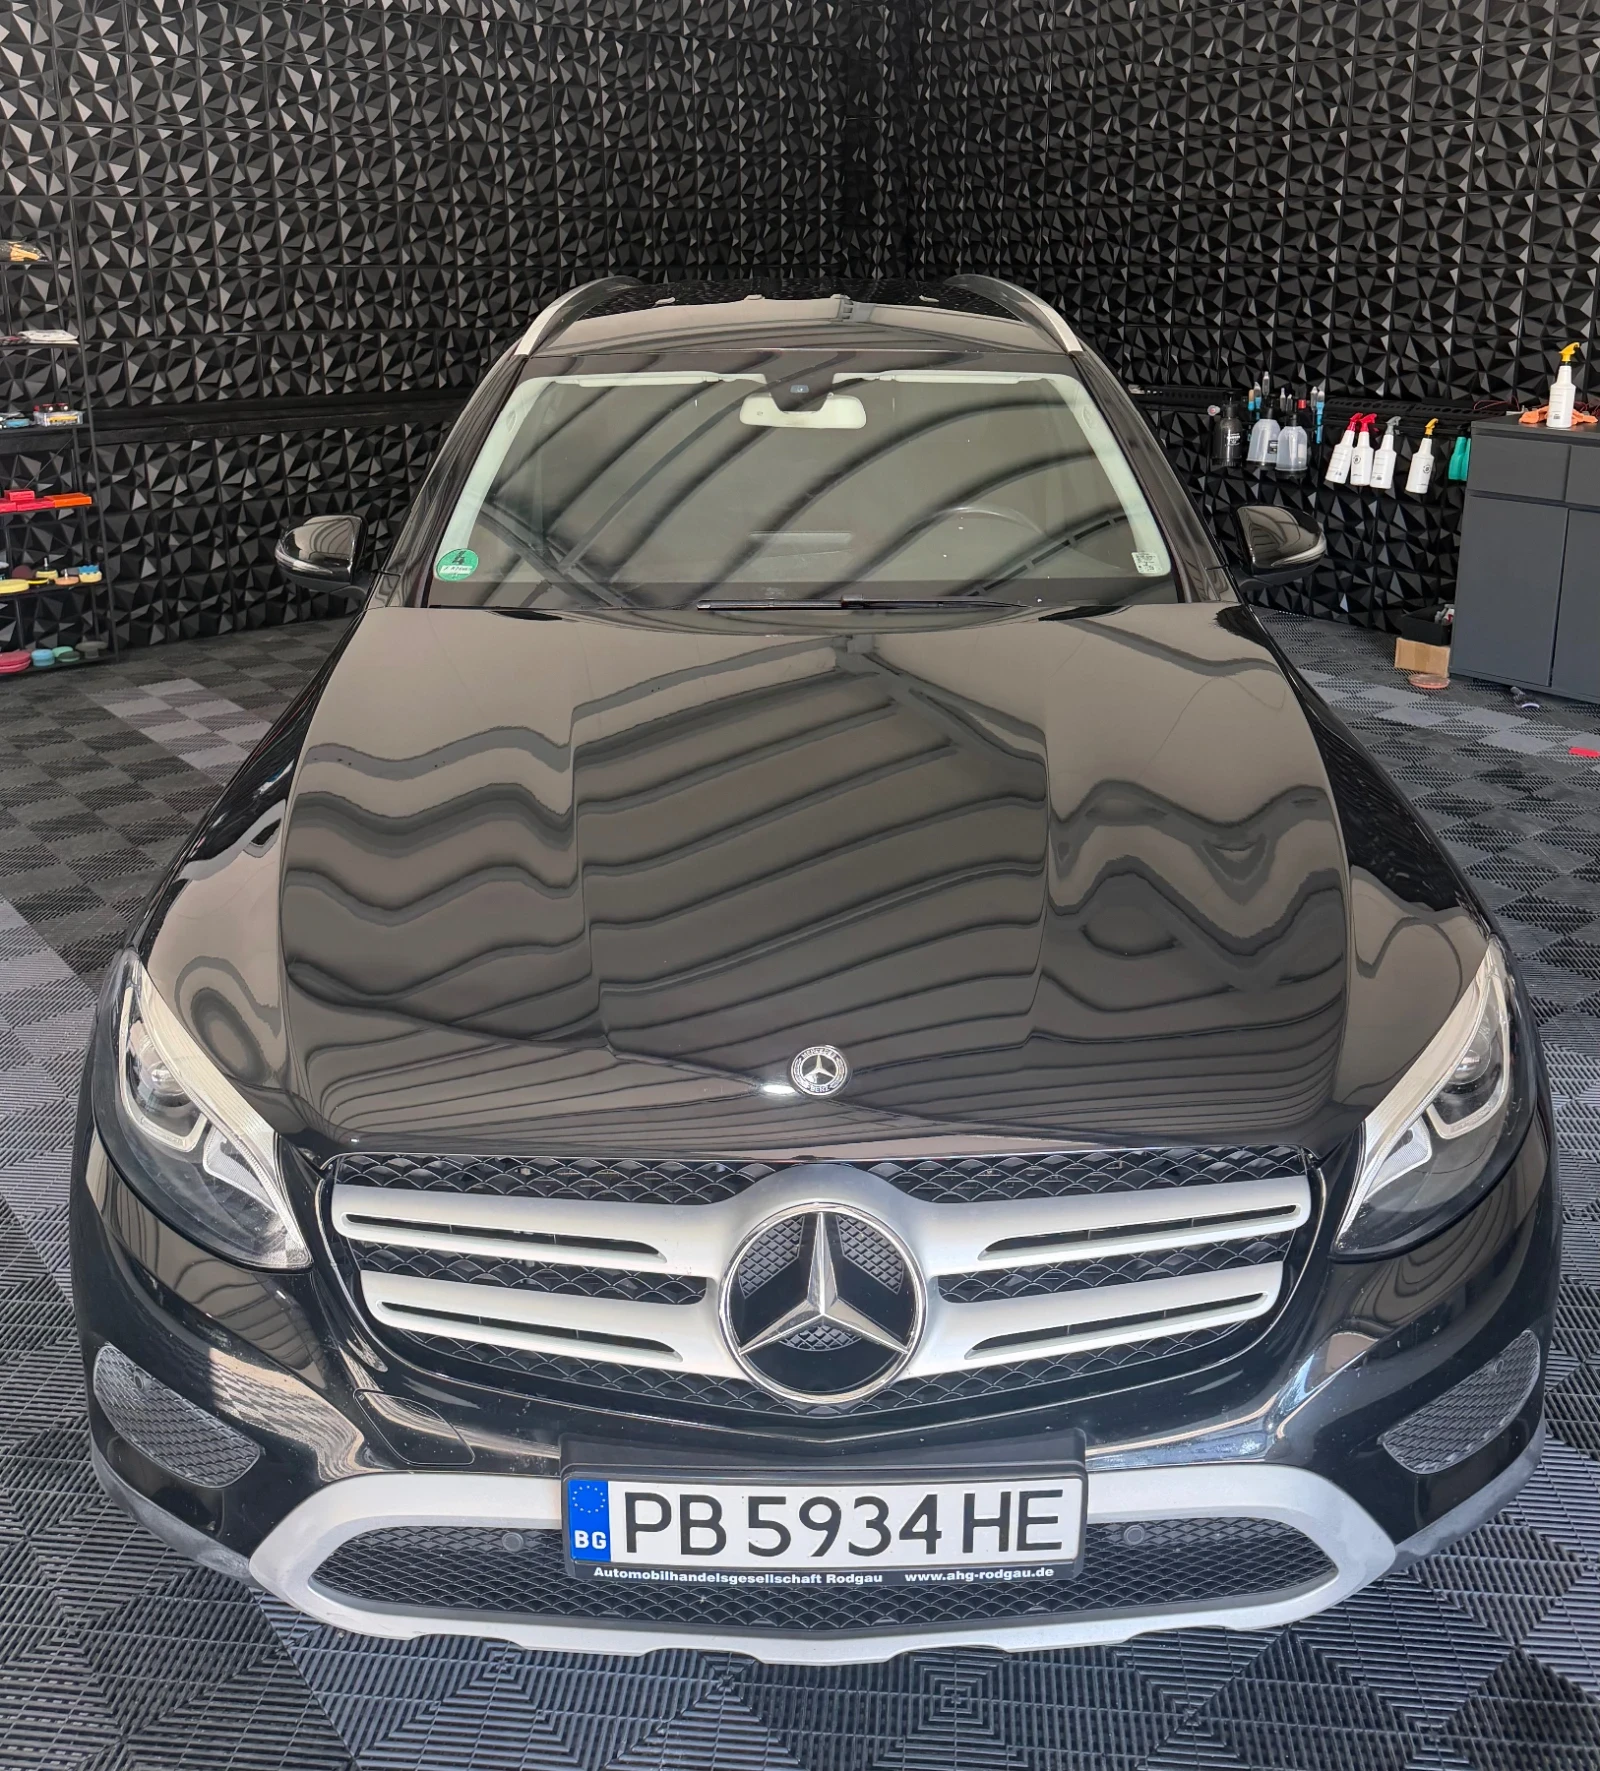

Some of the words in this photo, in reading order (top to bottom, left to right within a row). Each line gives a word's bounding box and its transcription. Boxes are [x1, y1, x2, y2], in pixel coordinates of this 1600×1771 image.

[452, 550, 467, 565] 4
[624, 1491, 727, 1556] PB
[748, 1494, 943, 1557] 5934
[962, 1489, 1064, 1553] HE
[574, 1530, 607, 1549] BG
[594, 1566, 822, 1585] Automobilhandelsgesellschaft
[826, 1573, 883, 1585] Rodgau
[904, 1566, 1054, 1582] www.ahg-rodgau.de
